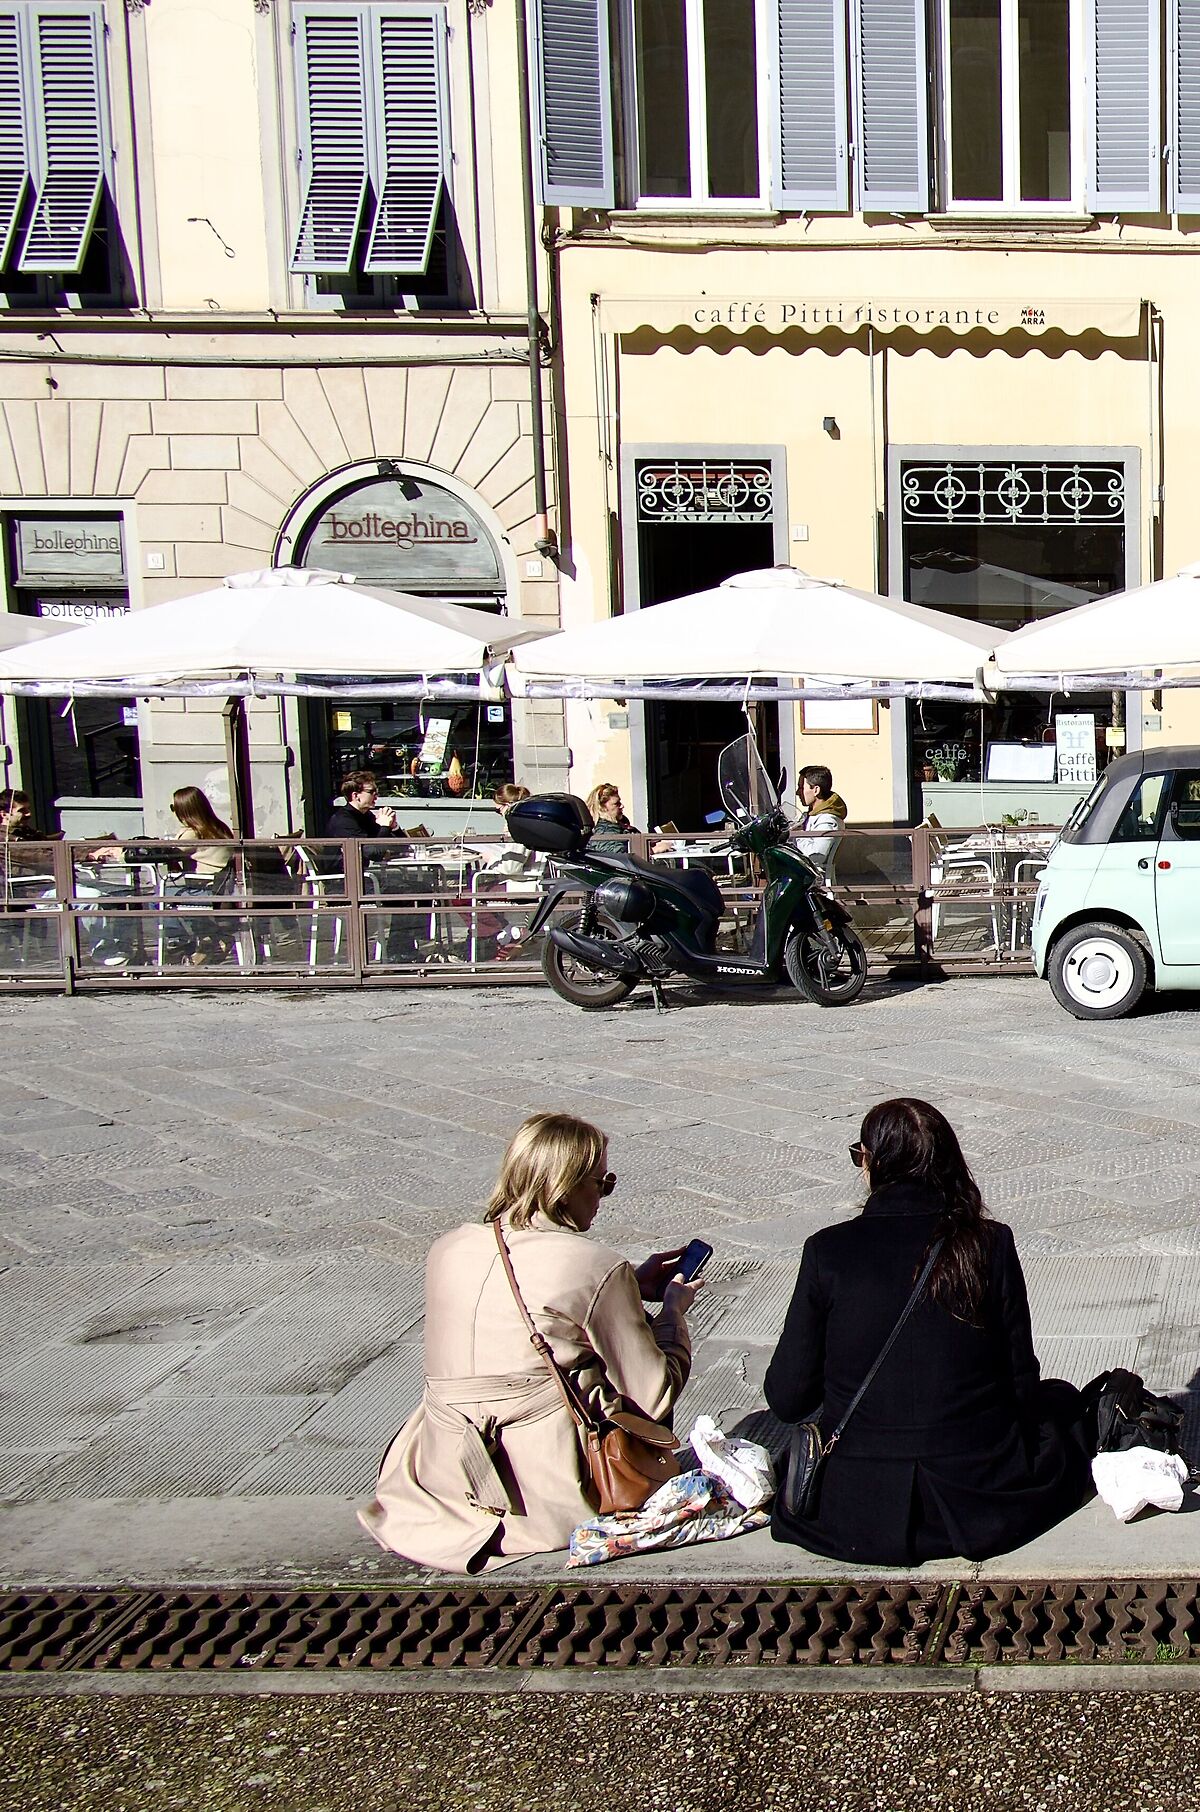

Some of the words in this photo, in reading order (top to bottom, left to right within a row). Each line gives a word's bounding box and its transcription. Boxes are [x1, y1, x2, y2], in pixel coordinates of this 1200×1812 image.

[694, 302, 766, 323] caffé
[780, 303, 845, 323] Pitti
[855, 301, 999, 324] ristorante
[1020, 317, 1046, 325] ARRA
[331, 513, 470, 550] botteghina
[33, 529, 120, 556] botteghina
[1059, 768, 1096, 782] Pitti
[716, 965, 765, 976] HONDA
